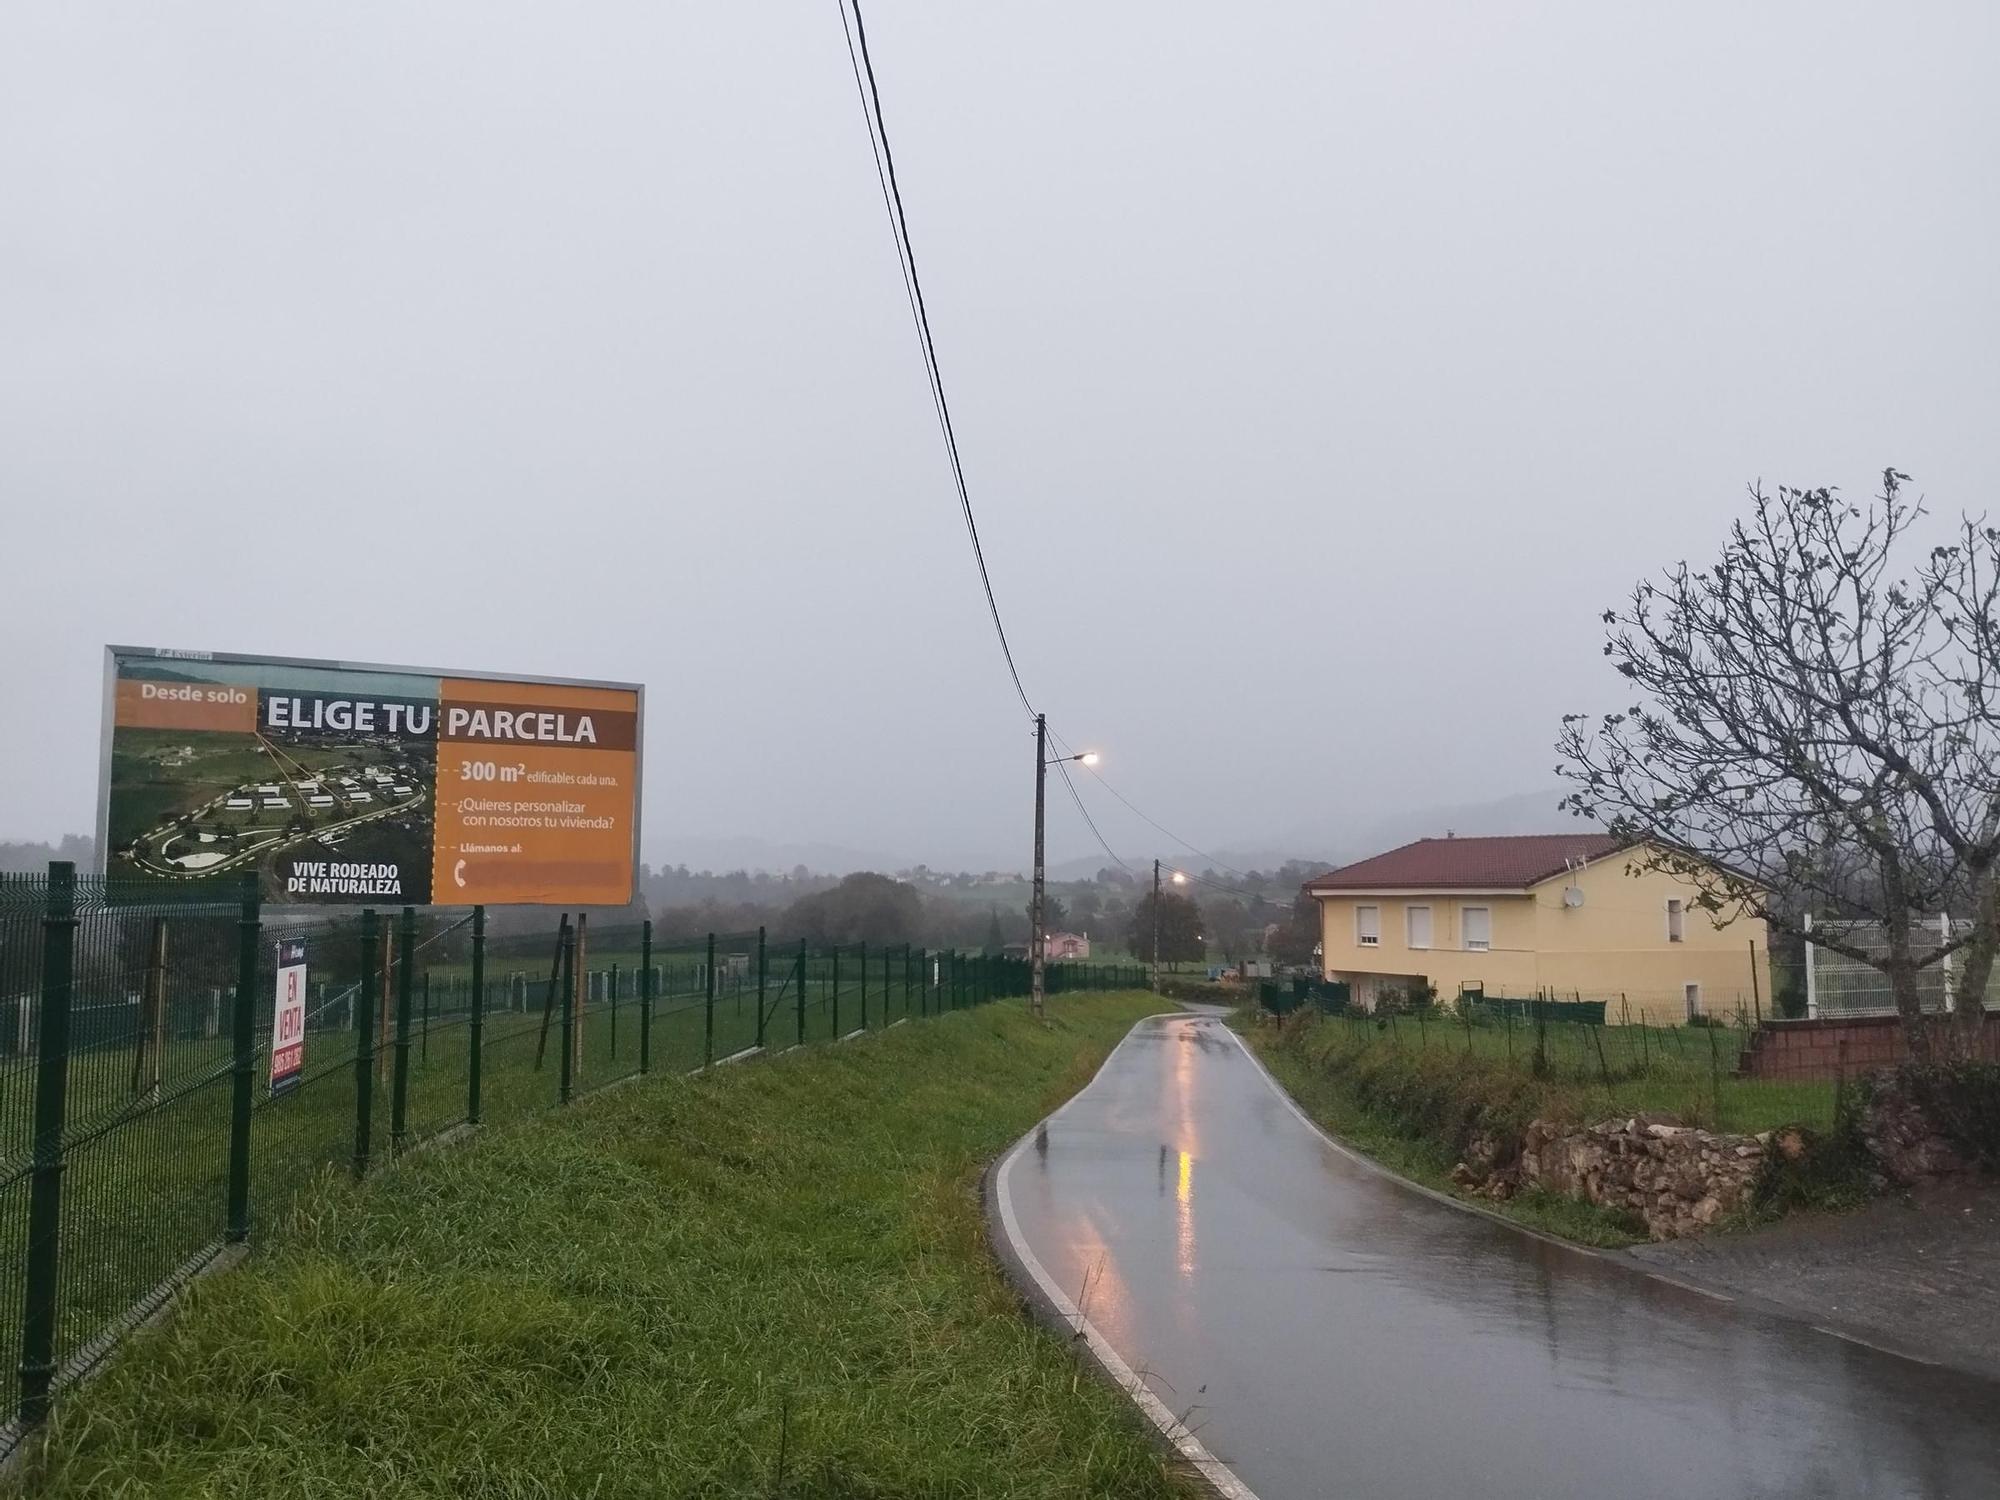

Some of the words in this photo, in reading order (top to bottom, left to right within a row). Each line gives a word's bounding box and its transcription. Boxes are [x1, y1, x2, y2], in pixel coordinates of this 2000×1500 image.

[142, 684, 203, 701] Desde
[207, 688, 247, 704] solo
[268, 696, 375, 731] ELIGE
[382, 703, 430, 734] TU
[448, 708, 597, 743] PARCELA
[460, 760, 496, 782] 300
[527, 771, 575, 785] edificables
[576, 775, 597, 786] cada
[599, 778, 618, 786] una.
[457, 798, 512, 813] ¿Quieres
[513, 800, 586, 814] personalizar
[463, 816, 486, 826] con
[489, 816, 542, 828] nosotros
[544, 818, 557, 828] tu
[559, 817, 614, 829] vivienda?
[460, 843, 508, 853] Llámanos
[510, 844, 522, 853] al:
[293, 862, 327, 877] VIVE
[330, 863, 398, 879] RODEADO
[288, 878, 307, 892] DE
[310, 878, 401, 894] NATURALEZA
[287, 971, 297, 1003] EN
[280, 1005, 302, 1041] VENTA
